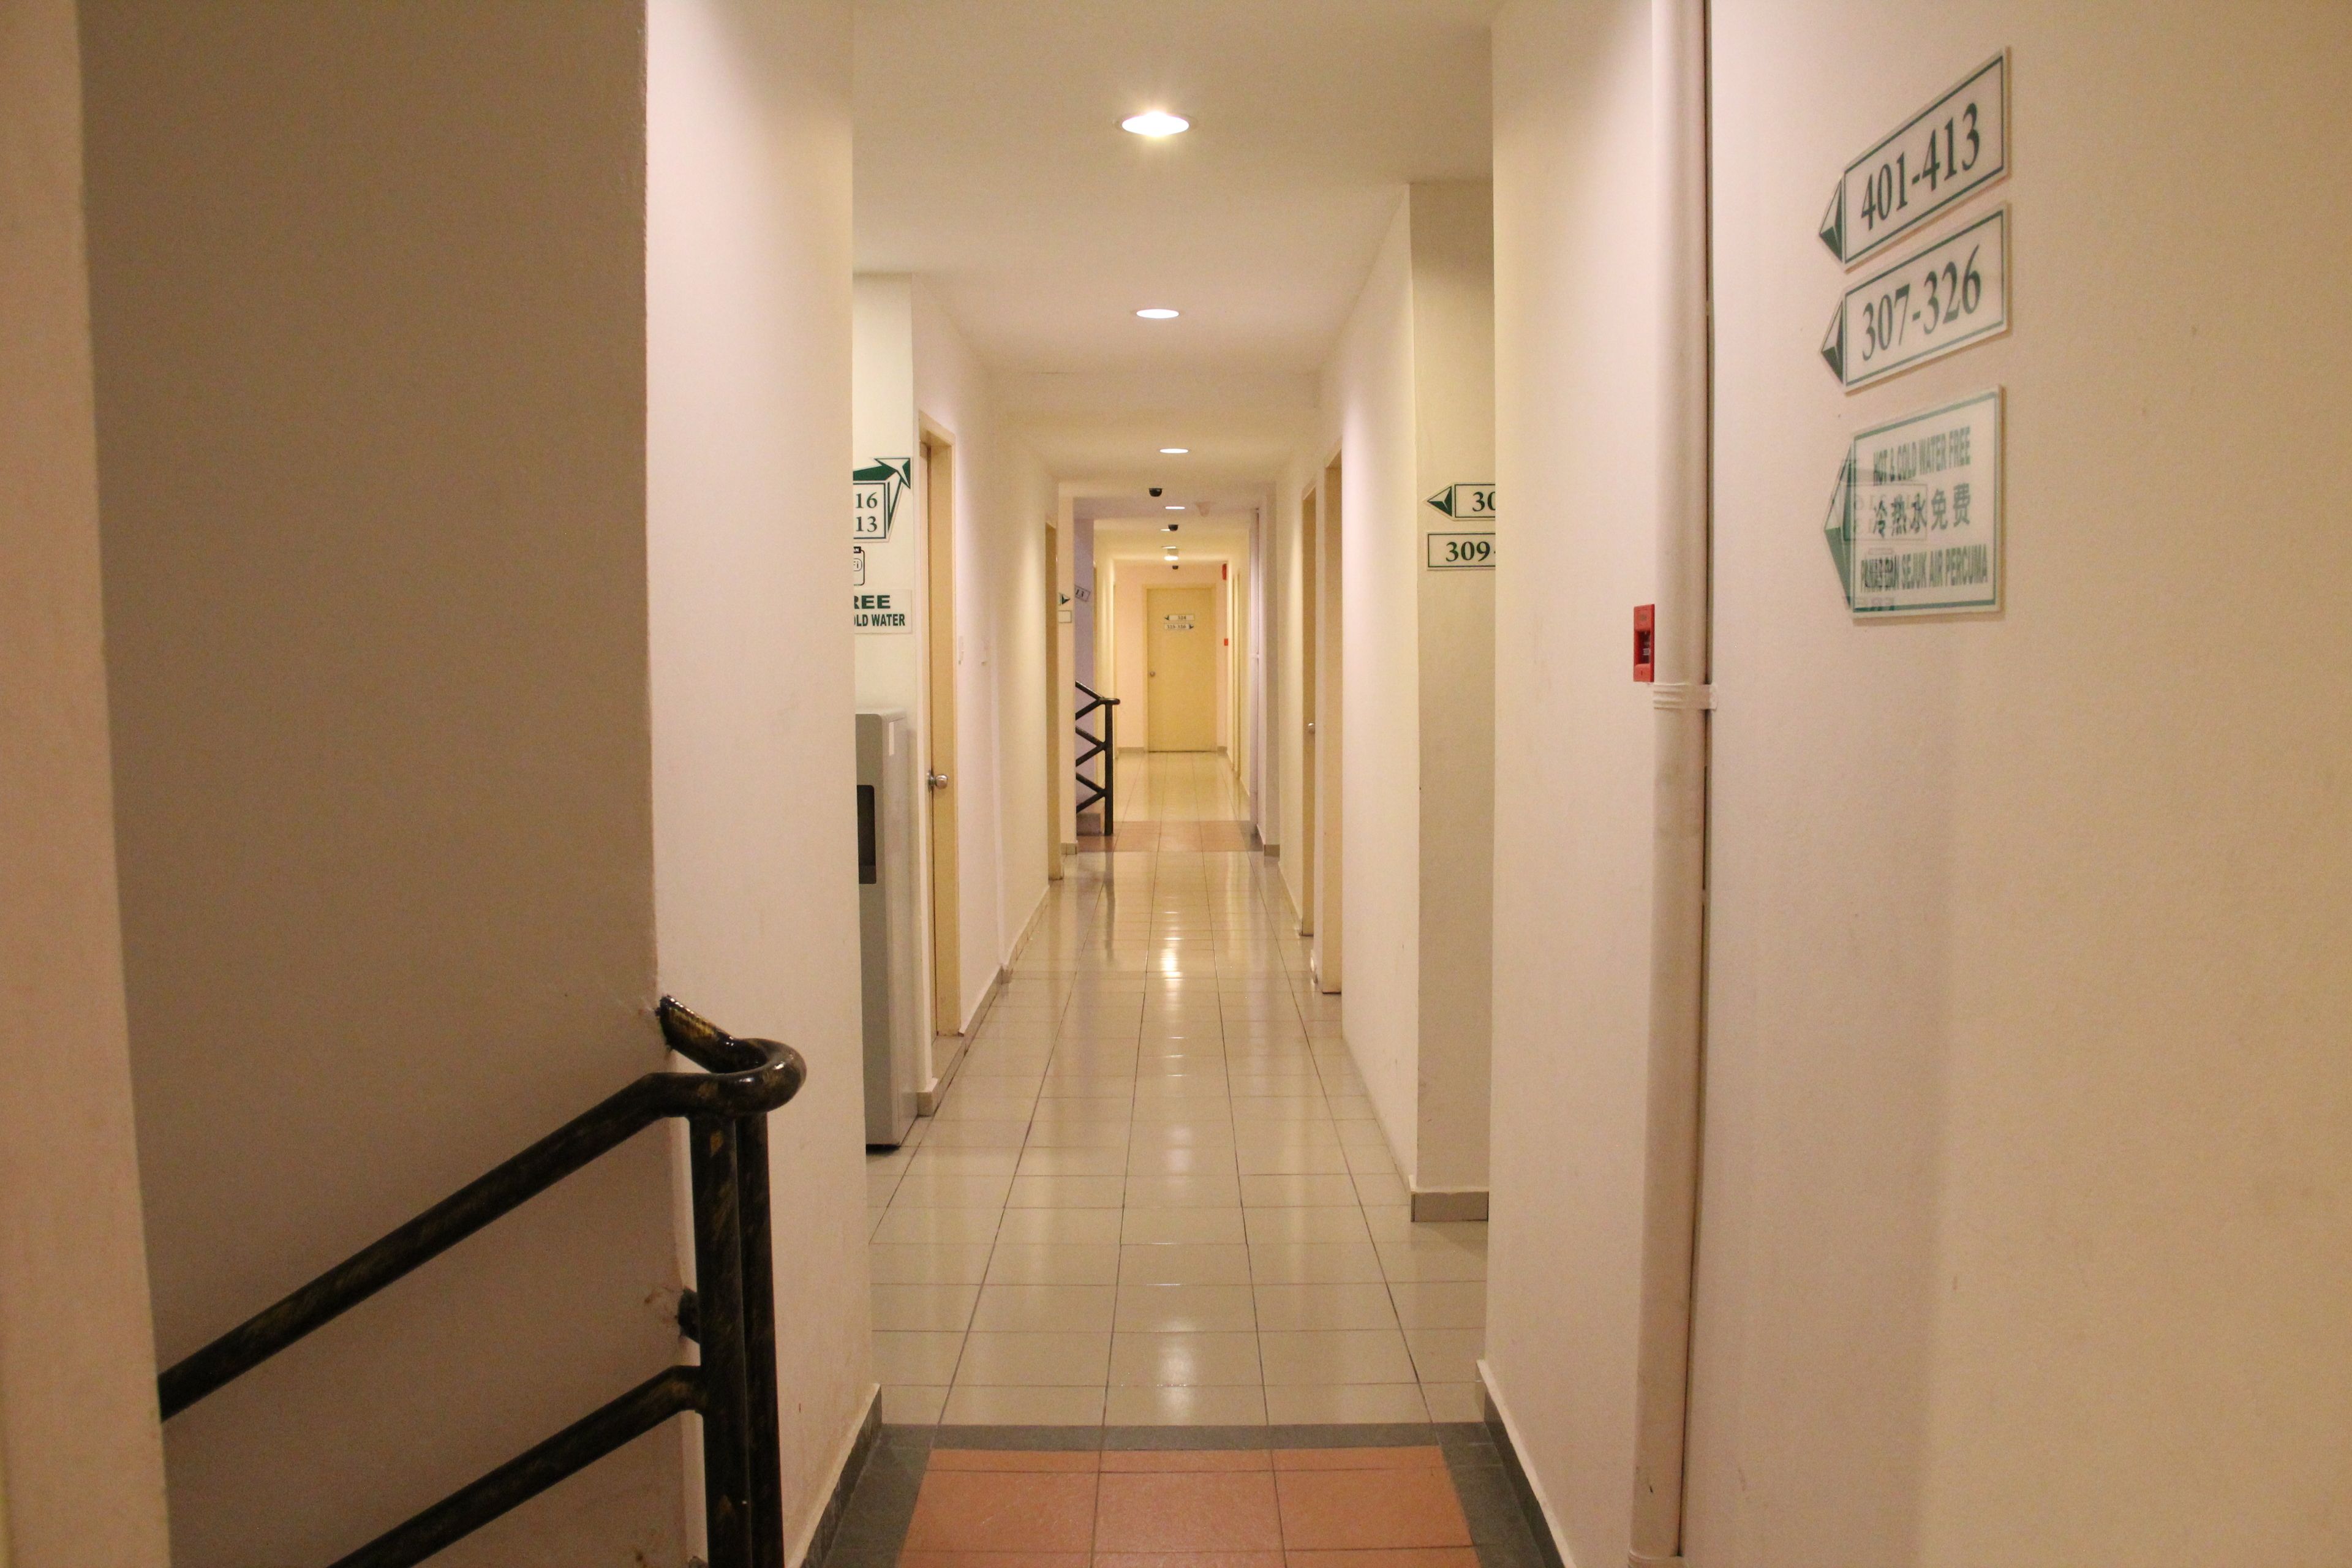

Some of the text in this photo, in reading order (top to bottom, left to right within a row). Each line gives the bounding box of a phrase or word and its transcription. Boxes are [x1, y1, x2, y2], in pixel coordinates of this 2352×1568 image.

[1861, 102, 1981, 231] 401-413
[1862, 243, 1981, 361] 307-326
[1949, 425, 1970, 469] FREE
[1446, 541, 1495, 562] 309
[854, 613, 905, 627] LD WATER
